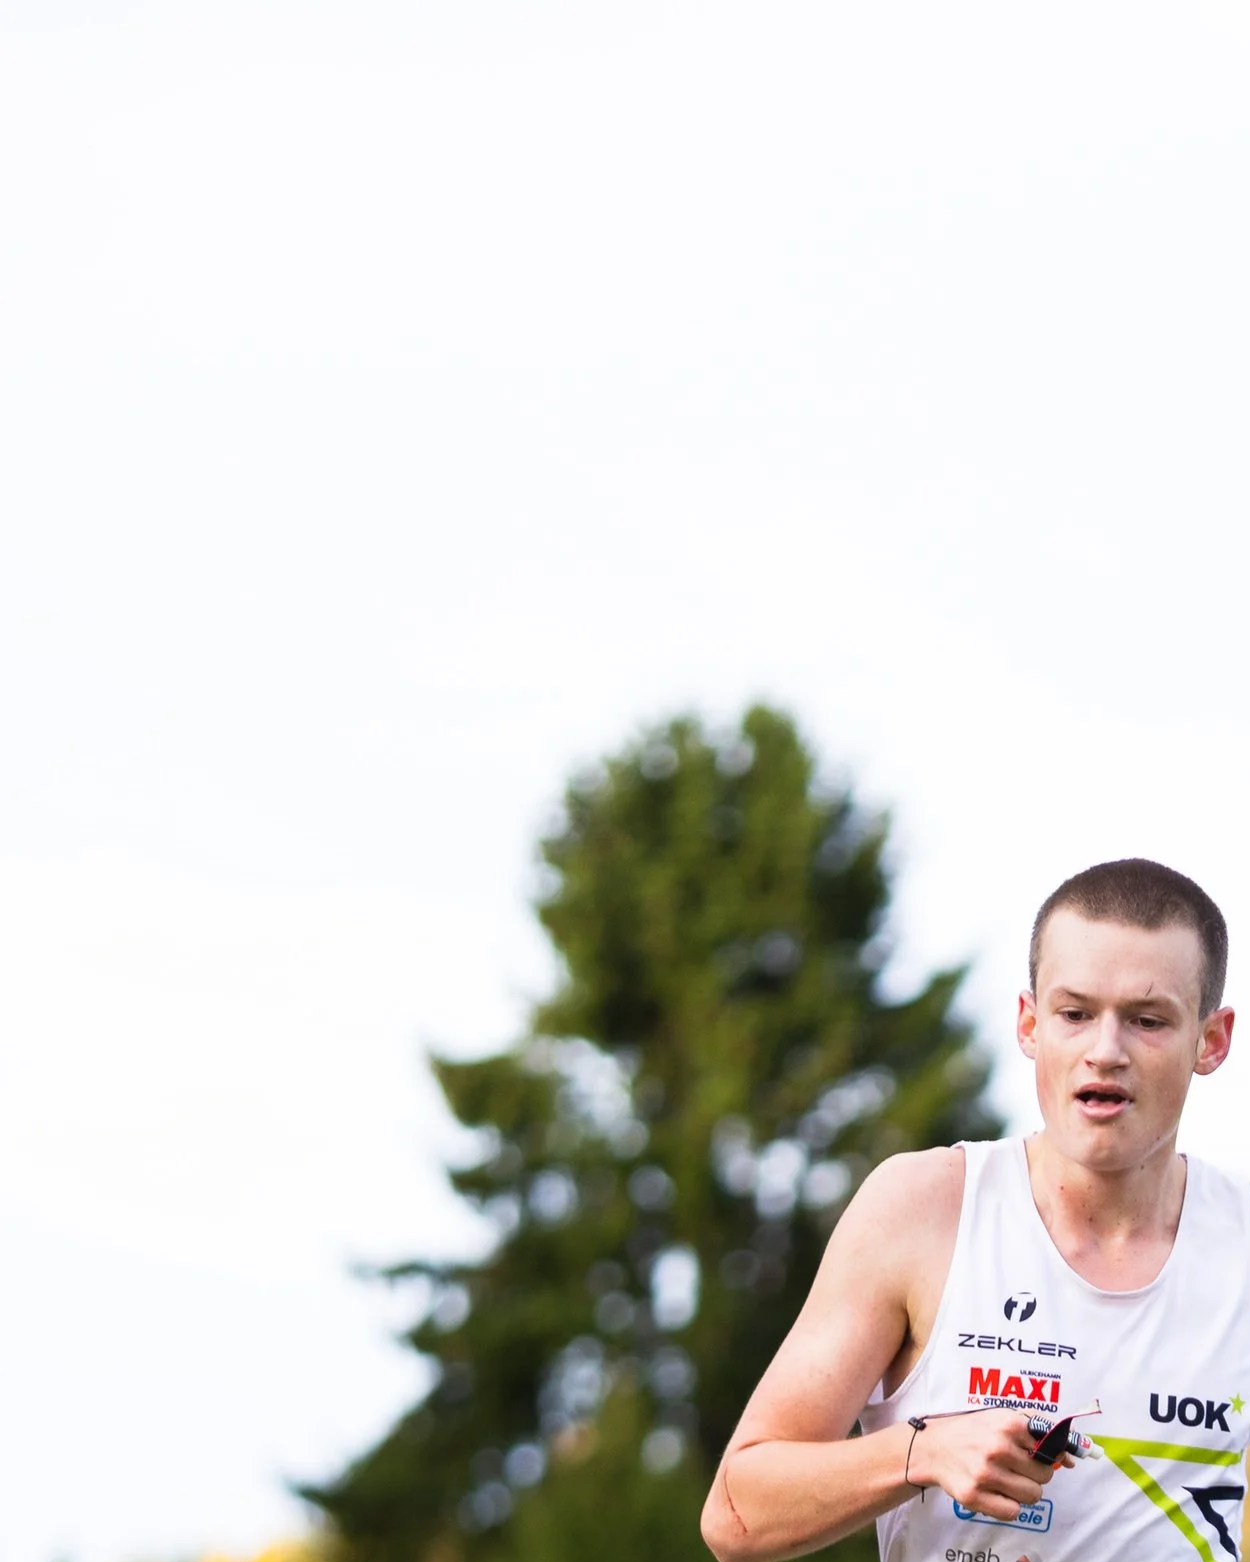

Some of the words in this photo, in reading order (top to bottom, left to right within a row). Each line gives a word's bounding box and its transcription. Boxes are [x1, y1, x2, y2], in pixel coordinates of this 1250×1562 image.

[958, 1333, 1077, 1360] ZEKLER
[969, 1367, 1060, 1404] MAXI
[967, 1396, 980, 1405] ICA
[983, 1397, 1059, 1413] STORMARKNAD
[1149, 1393, 1231, 1433] UOK
